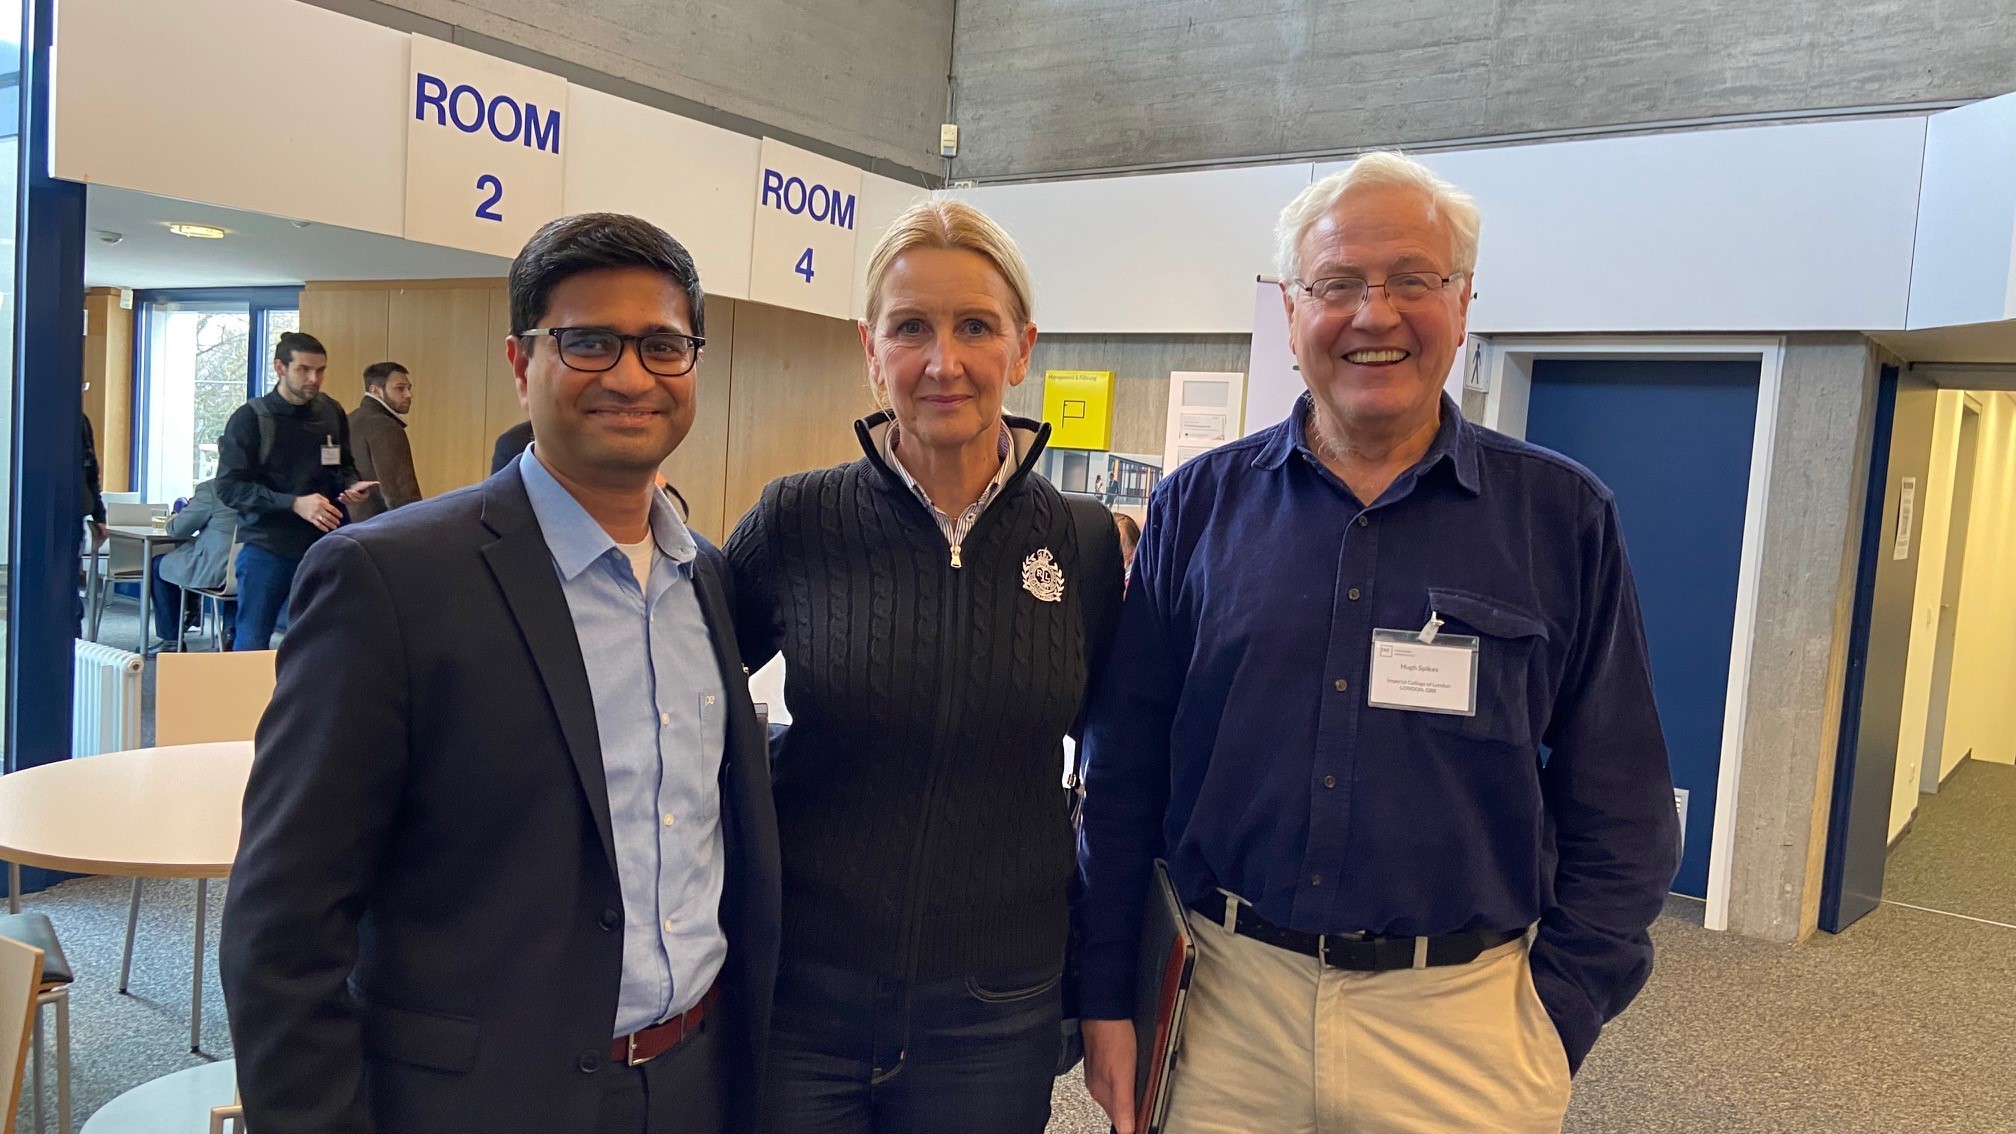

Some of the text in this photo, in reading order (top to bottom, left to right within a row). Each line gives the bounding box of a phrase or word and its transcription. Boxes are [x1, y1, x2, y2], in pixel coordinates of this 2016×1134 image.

[415, 73, 561, 154] ROOM
[476, 174, 503, 221] 2
[762, 169, 856, 228] ROOM
[795, 248, 814, 282] 4
[1418, 665, 1439, 673] Spikes
